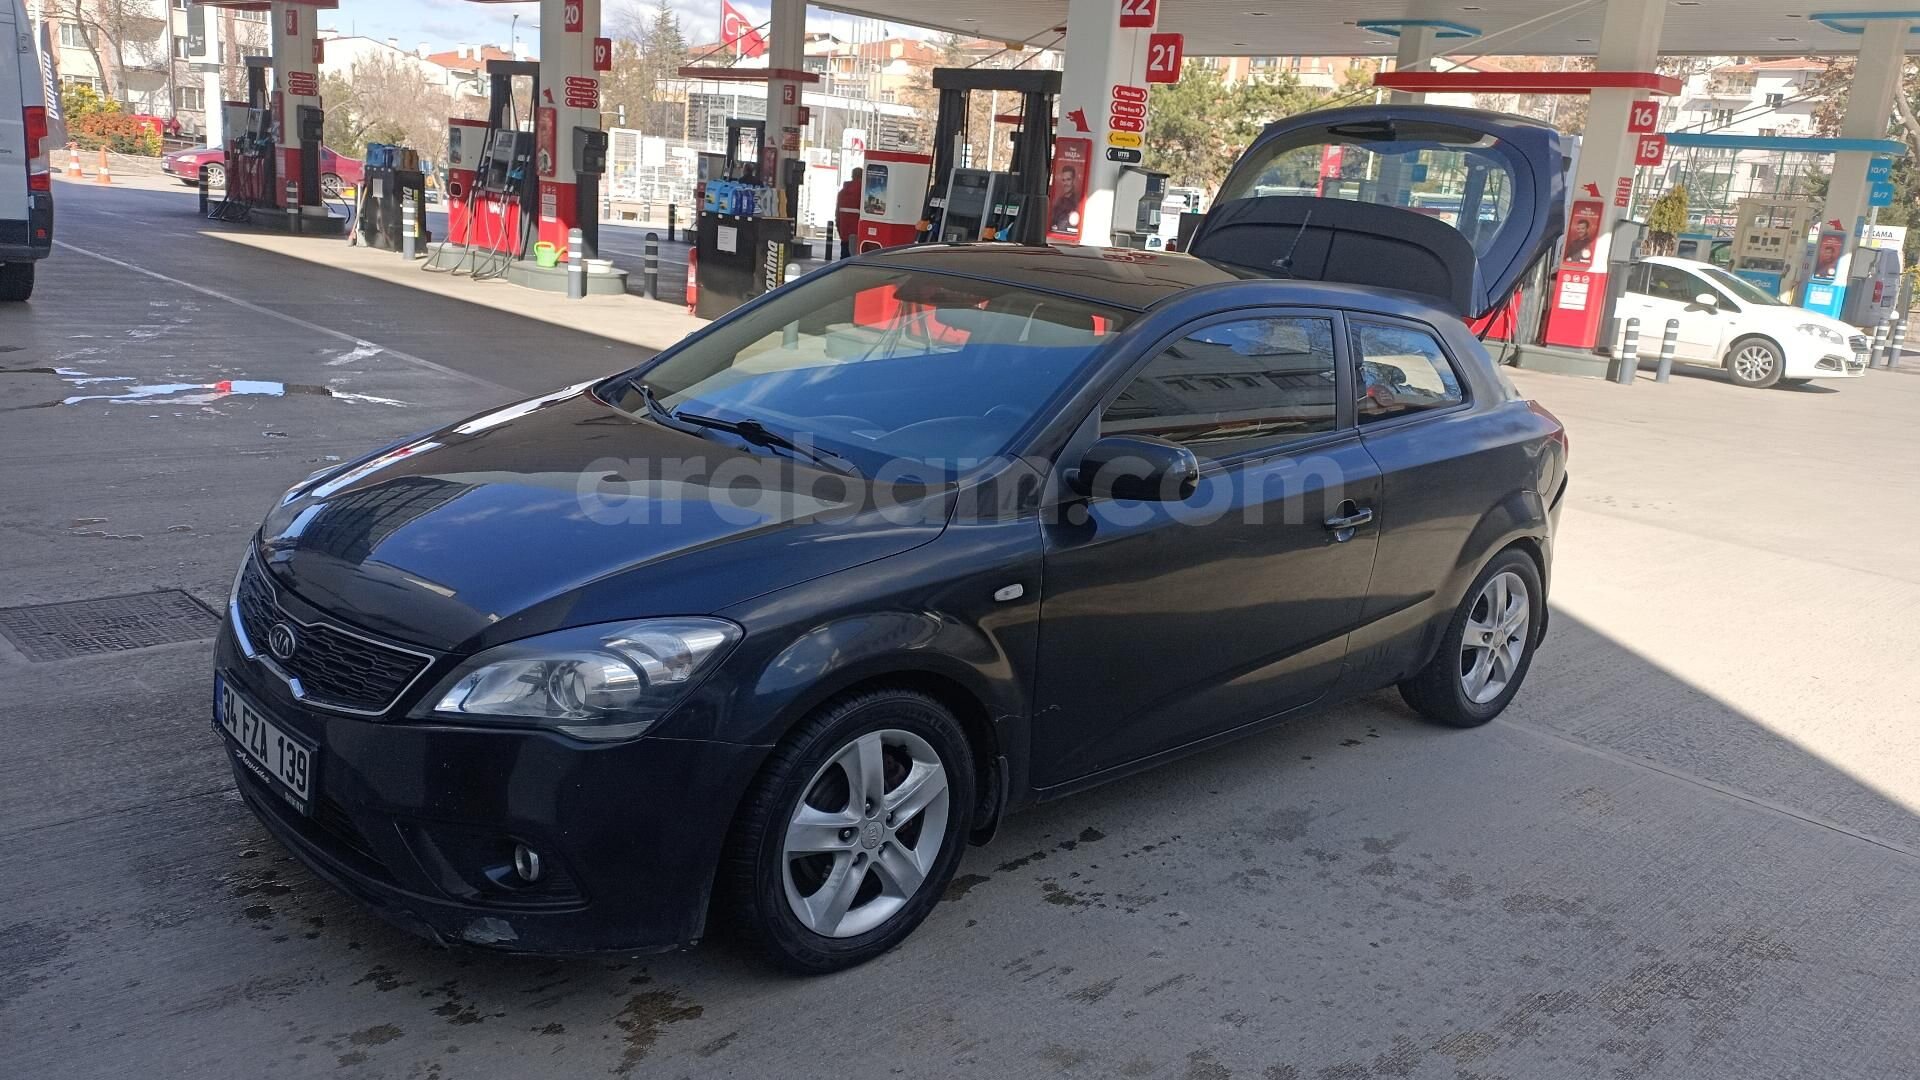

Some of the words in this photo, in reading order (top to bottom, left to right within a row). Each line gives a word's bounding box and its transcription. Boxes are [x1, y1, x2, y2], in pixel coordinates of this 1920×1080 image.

[566, 6, 579, 24] 20
[1121, 0, 1151, 15] 22
[595, 45, 606, 63] 19
[1150, 44, 1176, 71] 21
[42, 50, 59, 120] maxima
[785, 89, 793, 101] 12
[1634, 108, 1653, 127] 16
[1641, 141, 1661, 159] 15
[764, 240, 779, 293] axima
[274, 631, 290, 655] KIA
[223, 685, 237, 734] 34
[242, 703, 268, 764] FZA
[278, 735, 307, 793] 139
